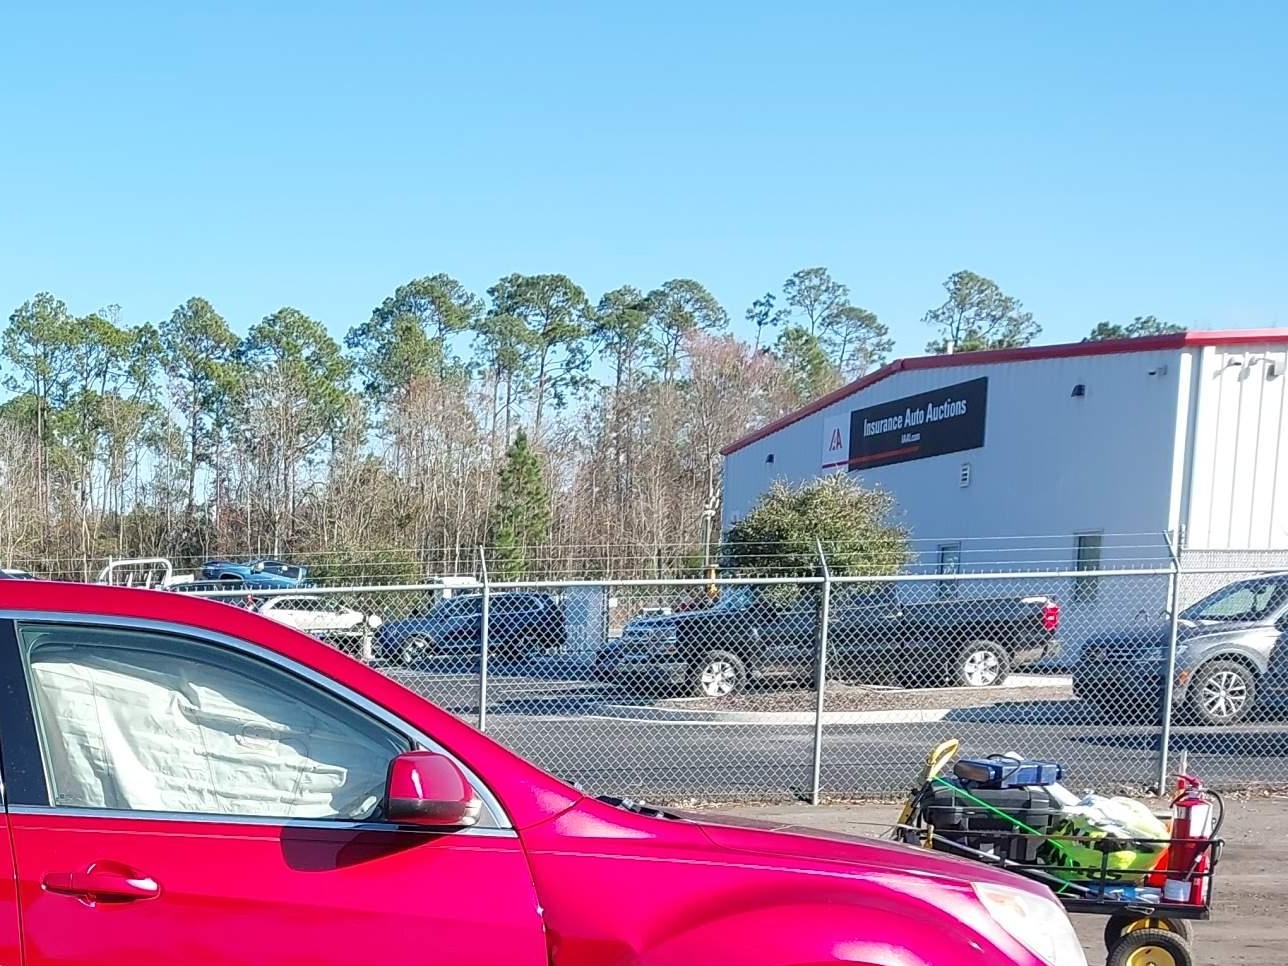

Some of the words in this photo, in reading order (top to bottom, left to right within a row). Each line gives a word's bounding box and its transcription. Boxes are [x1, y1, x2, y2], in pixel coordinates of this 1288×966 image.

[863, 415, 903, 436] Insurance
[904, 408, 924, 428] Auto
[926, 398, 967, 423] Auctions
